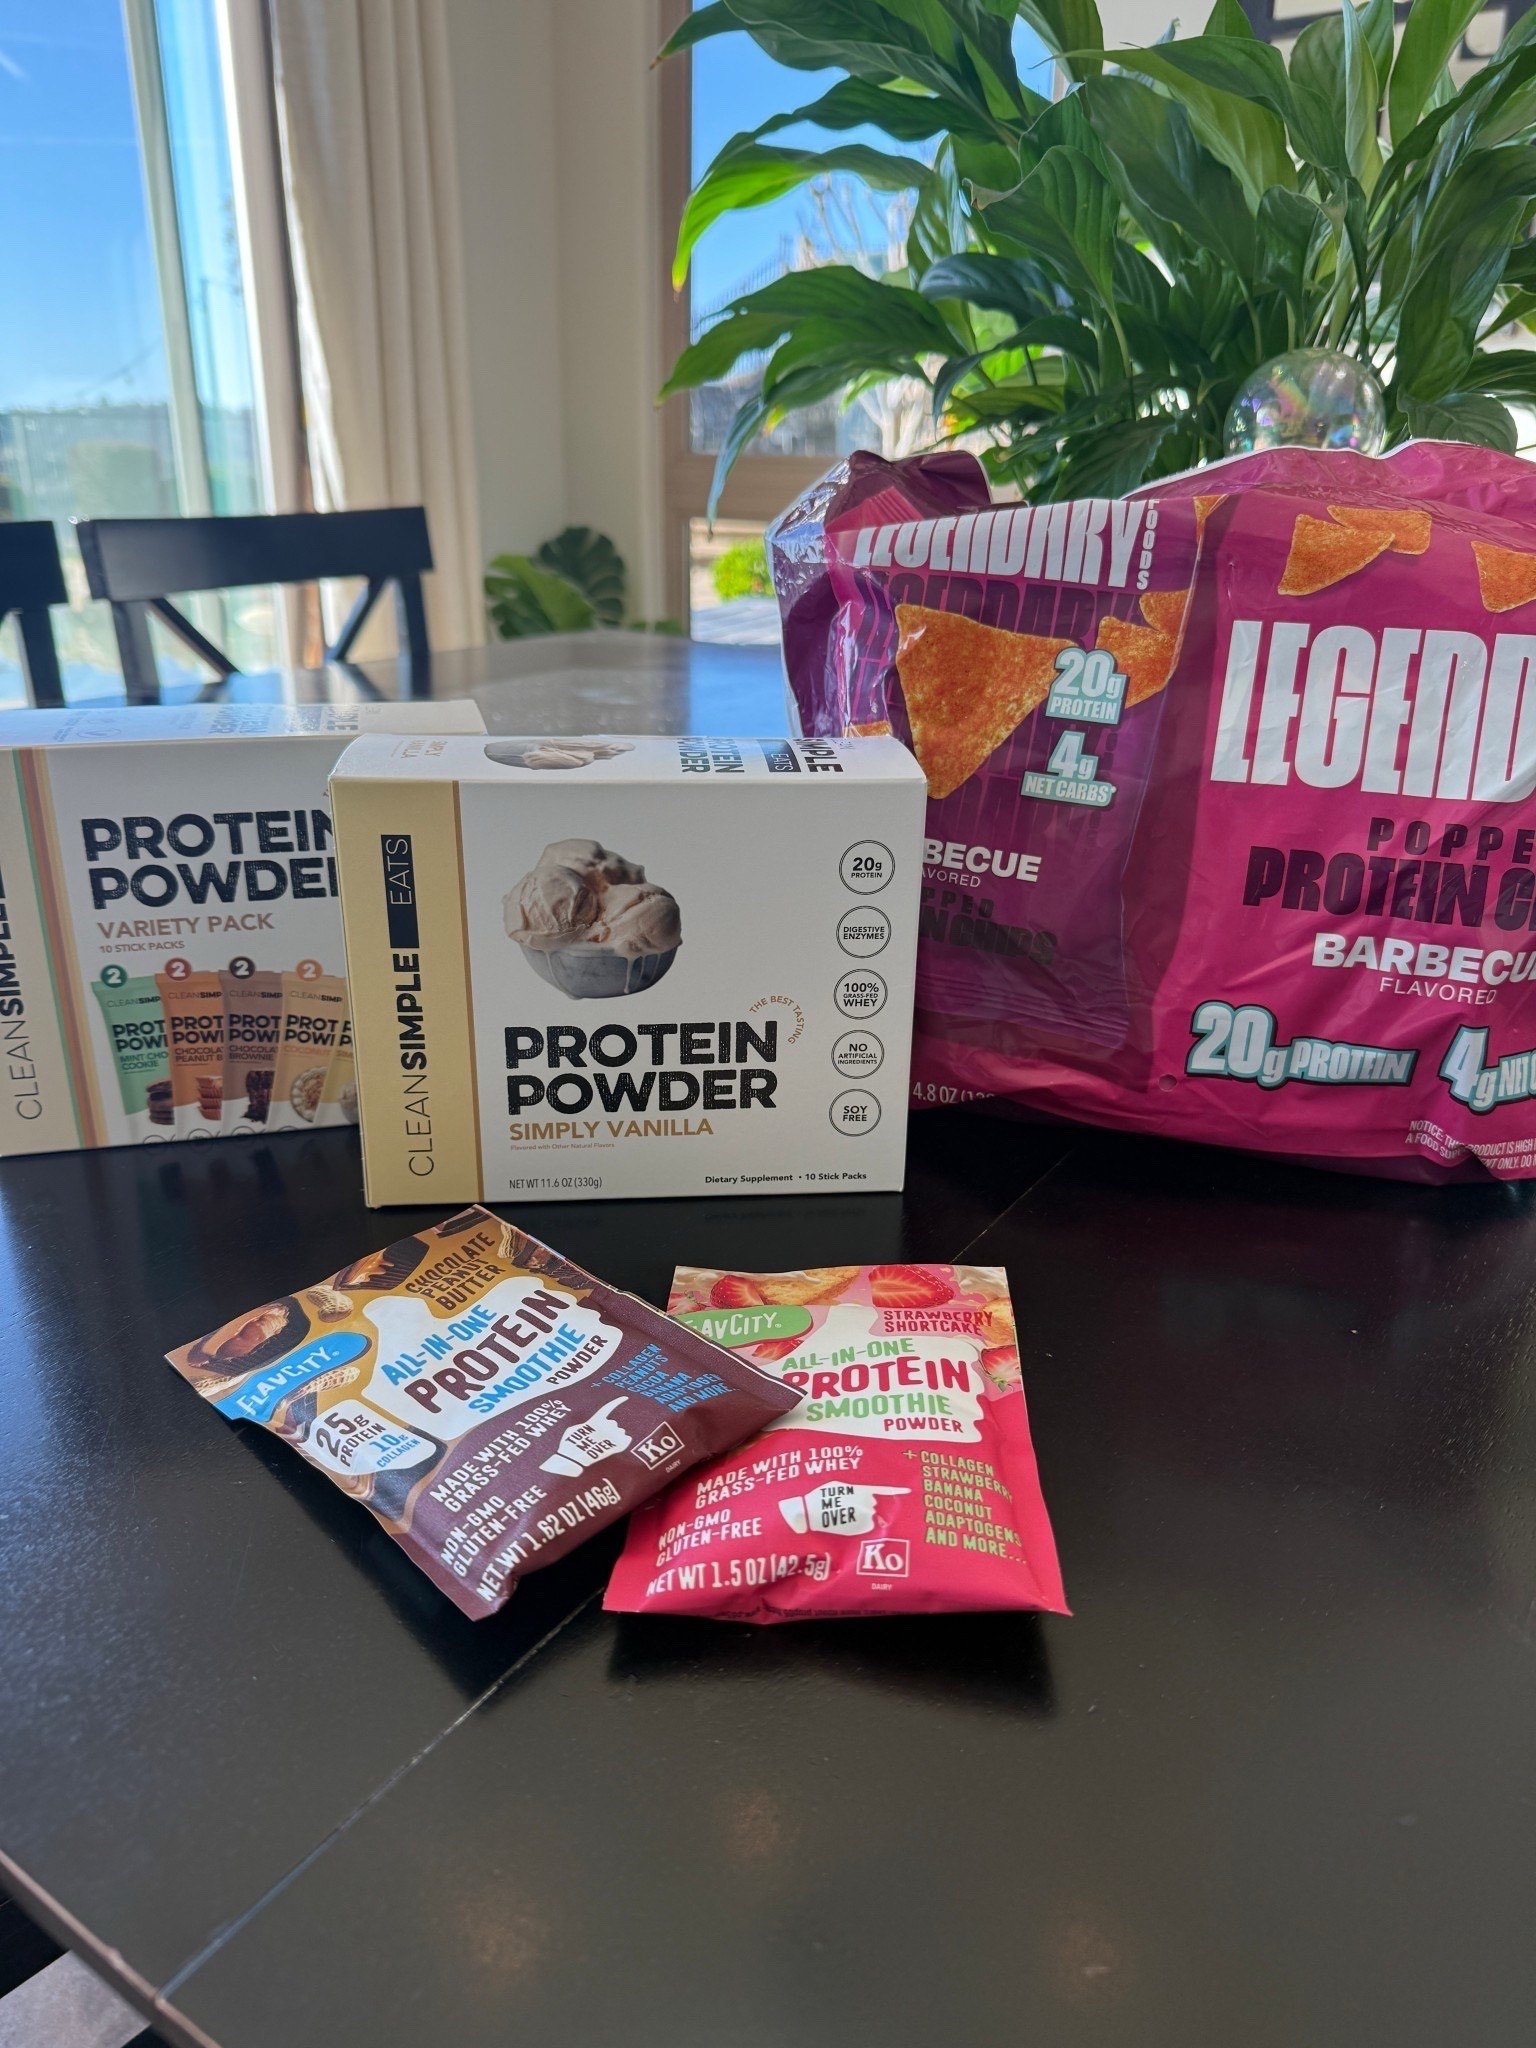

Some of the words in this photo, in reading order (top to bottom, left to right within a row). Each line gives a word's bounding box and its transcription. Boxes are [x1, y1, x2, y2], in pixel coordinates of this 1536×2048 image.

[1054, 651, 1122, 699] 20g
[1050, 697, 1117, 720] PROTEIN
[770, 753, 793, 771] EATS
[1052, 735, 1092, 780] 4g
[1025, 775, 1056, 794] NET
[386, 838, 413, 905] EATS
[852, 857, 882, 871] 20g
[89, 856, 339, 909] POWDE
[1242, 845, 1490, 928] PROTEIN
[97, 917, 200, 939] VARIETY
[208, 913, 275, 933] PACK
[100, 945, 112, 954] 10
[115, 943, 145, 952] STICK
[149, 941, 185, 950] PACKS
[1312, 932, 1536, 986] BARBECU
[107, 968, 122, 984] 2
[171, 961, 186, 977] 2
[235, 961, 250, 976] 2
[302, 963, 317, 979] 2
[843, 983, 879, 993] 100%
[1379, 977, 1497, 1006] FLAVORED
[843, 999, 878, 1007] WHEY
[749, 997, 768, 1013] THE
[770, 995, 794, 1007] BEST
[788, 1005, 805, 1045] TASTING
[229, 1053, 274, 1061] BROWNIE
[505, 1020, 777, 1069] PROTEIN
[849, 1043, 868, 1052] NO
[1191, 1005, 1287, 1085] 20g
[1290, 1039, 1412, 1081] PROTEIN
[120, 1053, 145, 1063] MINT
[121, 1060, 160, 1071] COOKIE
[176, 1054, 215, 1063] PEANUT
[1444, 1031, 1497, 1107] 4g
[1497, 1056, 1528, 1097] NET
[507, 1068, 778, 1115] POWDER
[913, 1082, 936, 1102] 4.8
[939, 1086, 959, 1104] OZ
[842, 1114, 867, 1122] FREE
[843, 1105, 868, 1114] SOY
[509, 1121, 600, 1141] SIMPLY
[606, 1118, 714, 1138] VANILLA
[1405, 1132, 1415, 1144] A
[1415, 1132, 1439, 1152] FOOD
[1521, 1154, 1532, 1167] DO
[1506, 1141, 1515, 1154] IS
[1515, 1138, 1533, 1152] HIGH
[509, 1179, 525, 1188] NET
[526, 1179, 539, 1188] WT
[541, 1178, 560, 1188] 11.6
[561, 1178, 573, 1187] OZ
[574, 1177, 602, 1188] (330g)
[705, 1176, 738, 1184] Dietary
[740, 1174, 793, 1183] Supplement
[818, 1172, 839, 1180] Stick
[842, 1172, 867, 1180] Packs
[405, 1231, 496, 1294] CHOCOLATE
[420, 1258, 489, 1299] PEANUT
[436, 1264, 506, 1311] BUTTER
[884, 1310, 993, 1327] STRAWBERRY
[885, 1320, 982, 1336] SHORTCAKE
[380, 1304, 497, 1386] ALL-IN-ONE
[404, 1289, 570, 1414] PROTEIN
[781, 1337, 915, 1371] ALL-IN-ONE
[468, 1323, 586, 1413] SMOOTHIE
[546, 1334, 608, 1385] POWDER
[602, 1343, 662, 1384] COLLAGEN
[614, 1354, 669, 1389] PEANUTS
[627, 1370, 670, 1393] COCOA
[640, 1372, 692, 1398] BANANA
[783, 1356, 970, 1400] PROTEIN
[667, 1396, 698, 1413] AND
[806, 1392, 954, 1422] SMOOTHIE
[316, 1412, 370, 1458] 25g
[565, 1424, 596, 1445] TURN
[884, 1417, 964, 1433] POWDER
[340, 1422, 387, 1467] PROTEIN
[369, 1433, 409, 1453] 10g
[376, 1438, 421, 1468] COLLAGEN
[429, 1461, 480, 1503] MADE
[473, 1429, 520, 1465] WITH
[515, 1399, 563, 1430] 100%
[576, 1436, 598, 1452] ME
[587, 1439, 616, 1459] OVER
[443, 1437, 531, 1513] GRASS-FED
[525, 1404, 572, 1438] WHEY
[665, 1460, 681, 1473] DAIRY
[696, 1466, 747, 1496] MADE
[752, 1450, 801, 1475] WITH
[808, 1445, 863, 1461] 100%
[921, 1450, 994, 1477] COLLAGEN
[695, 1464, 799, 1510] GRASS-FED
[804, 1457, 860, 1475] WHEY
[820, 1485, 854, 1498] TURN
[924, 1479, 983, 1502] BANANA
[821, 1499, 842, 1510] ME
[822, 1506, 857, 1529] OVER
[924, 1494, 992, 1520] COCONUT
[440, 1495, 505, 1566] NON-GMO
[452, 1485, 548, 1577] GLUTEN-FREE
[476, 1563, 504, 1602] NET
[495, 1540, 529, 1570] WT
[521, 1513, 565, 1551] 1.62
[558, 1501, 586, 1528] OZ
[576, 1477, 621, 1517] (46g)
[658, 1508, 731, 1551] NON-GMO
[925, 1510, 1022, 1547] ADAPTOGENS
[926, 1527, 958, 1547] AND
[656, 1517, 762, 1567] GLUTEN-FREE
[645, 1568, 675, 1597] NET
[678, 1563, 706, 1590] WT
[711, 1559, 742, 1588] 1.5
[745, 1557, 767, 1586] OZ
[771, 1552, 831, 1583] (42.5g)
